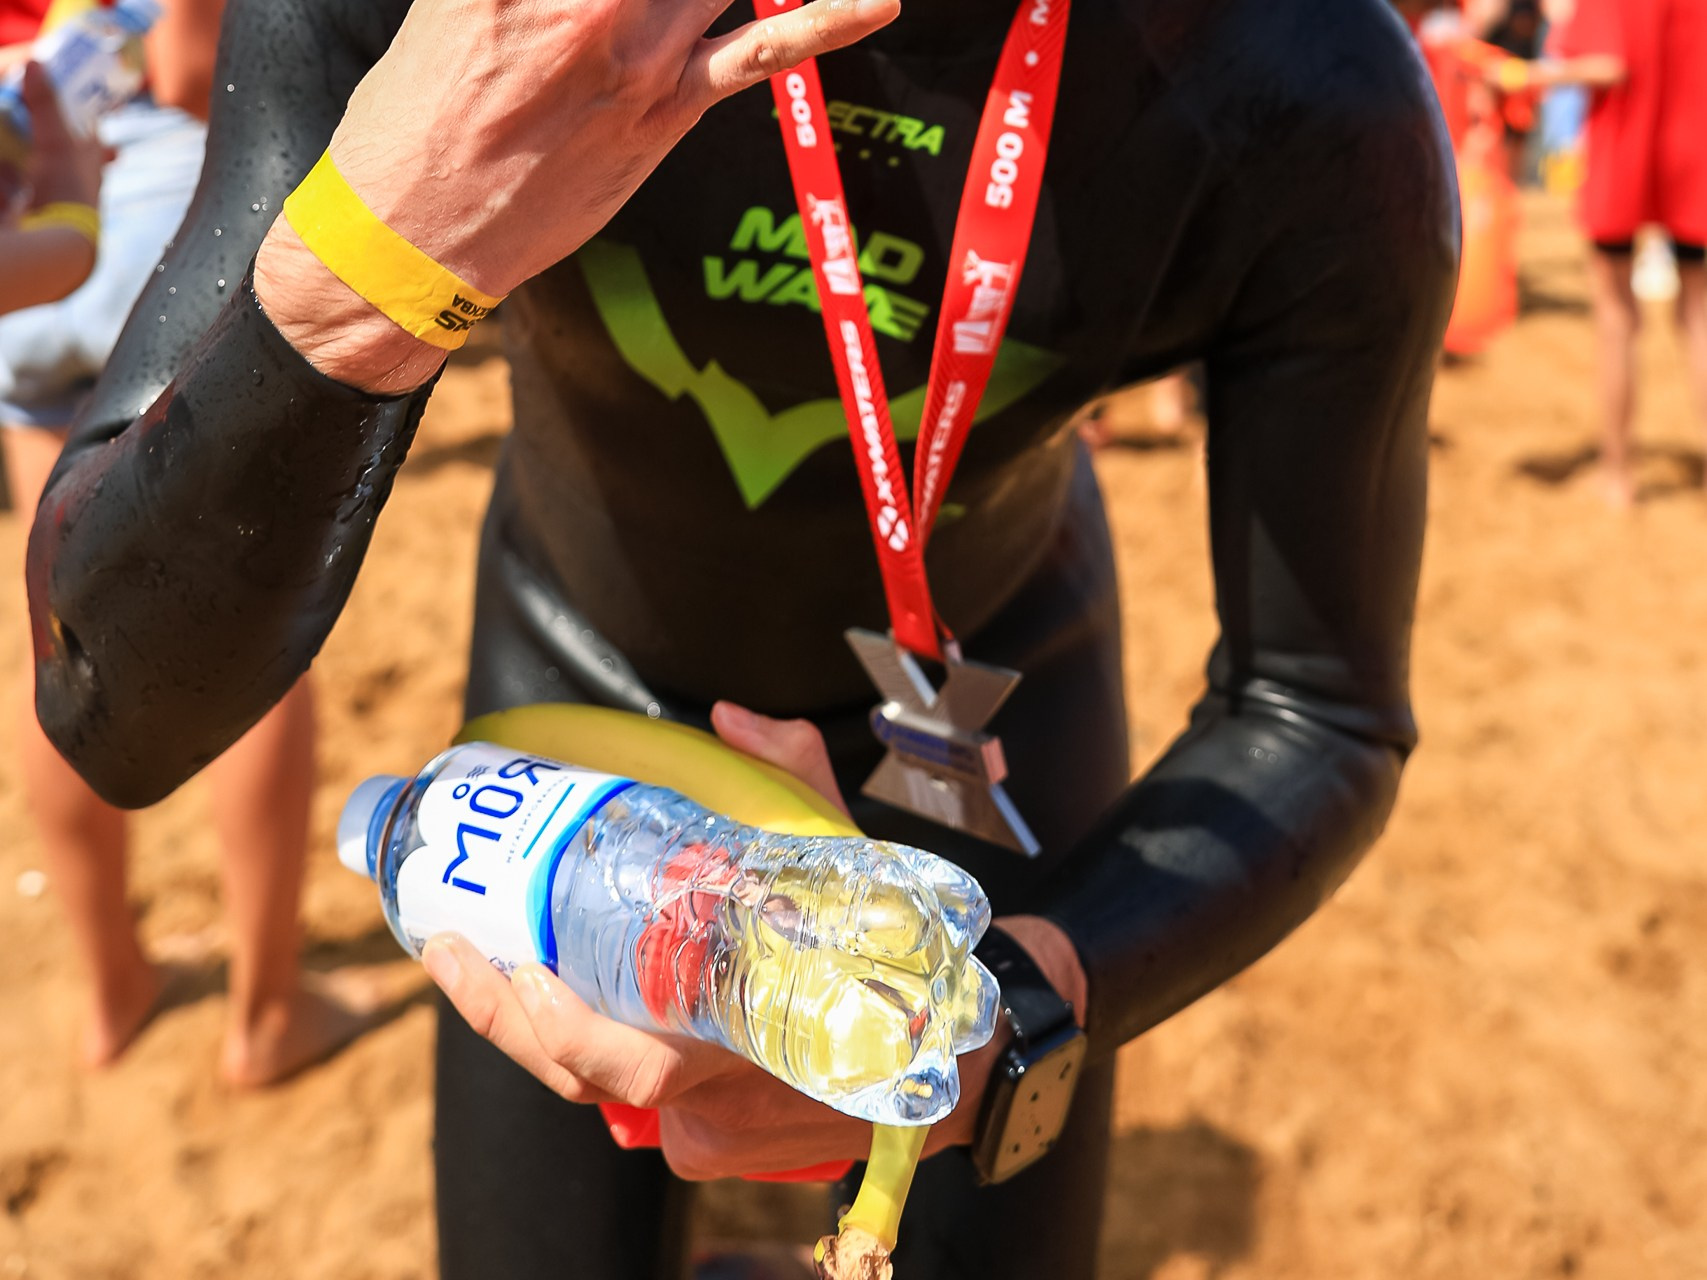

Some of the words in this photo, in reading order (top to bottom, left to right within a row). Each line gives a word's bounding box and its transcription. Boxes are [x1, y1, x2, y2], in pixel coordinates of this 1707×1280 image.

[772, 100, 946, 157] ECTRA
[786, 73, 818, 148] 500
[986, 131, 1024, 209] 500
[730, 206, 925, 285] MD
[703, 255, 931, 343] WAE
